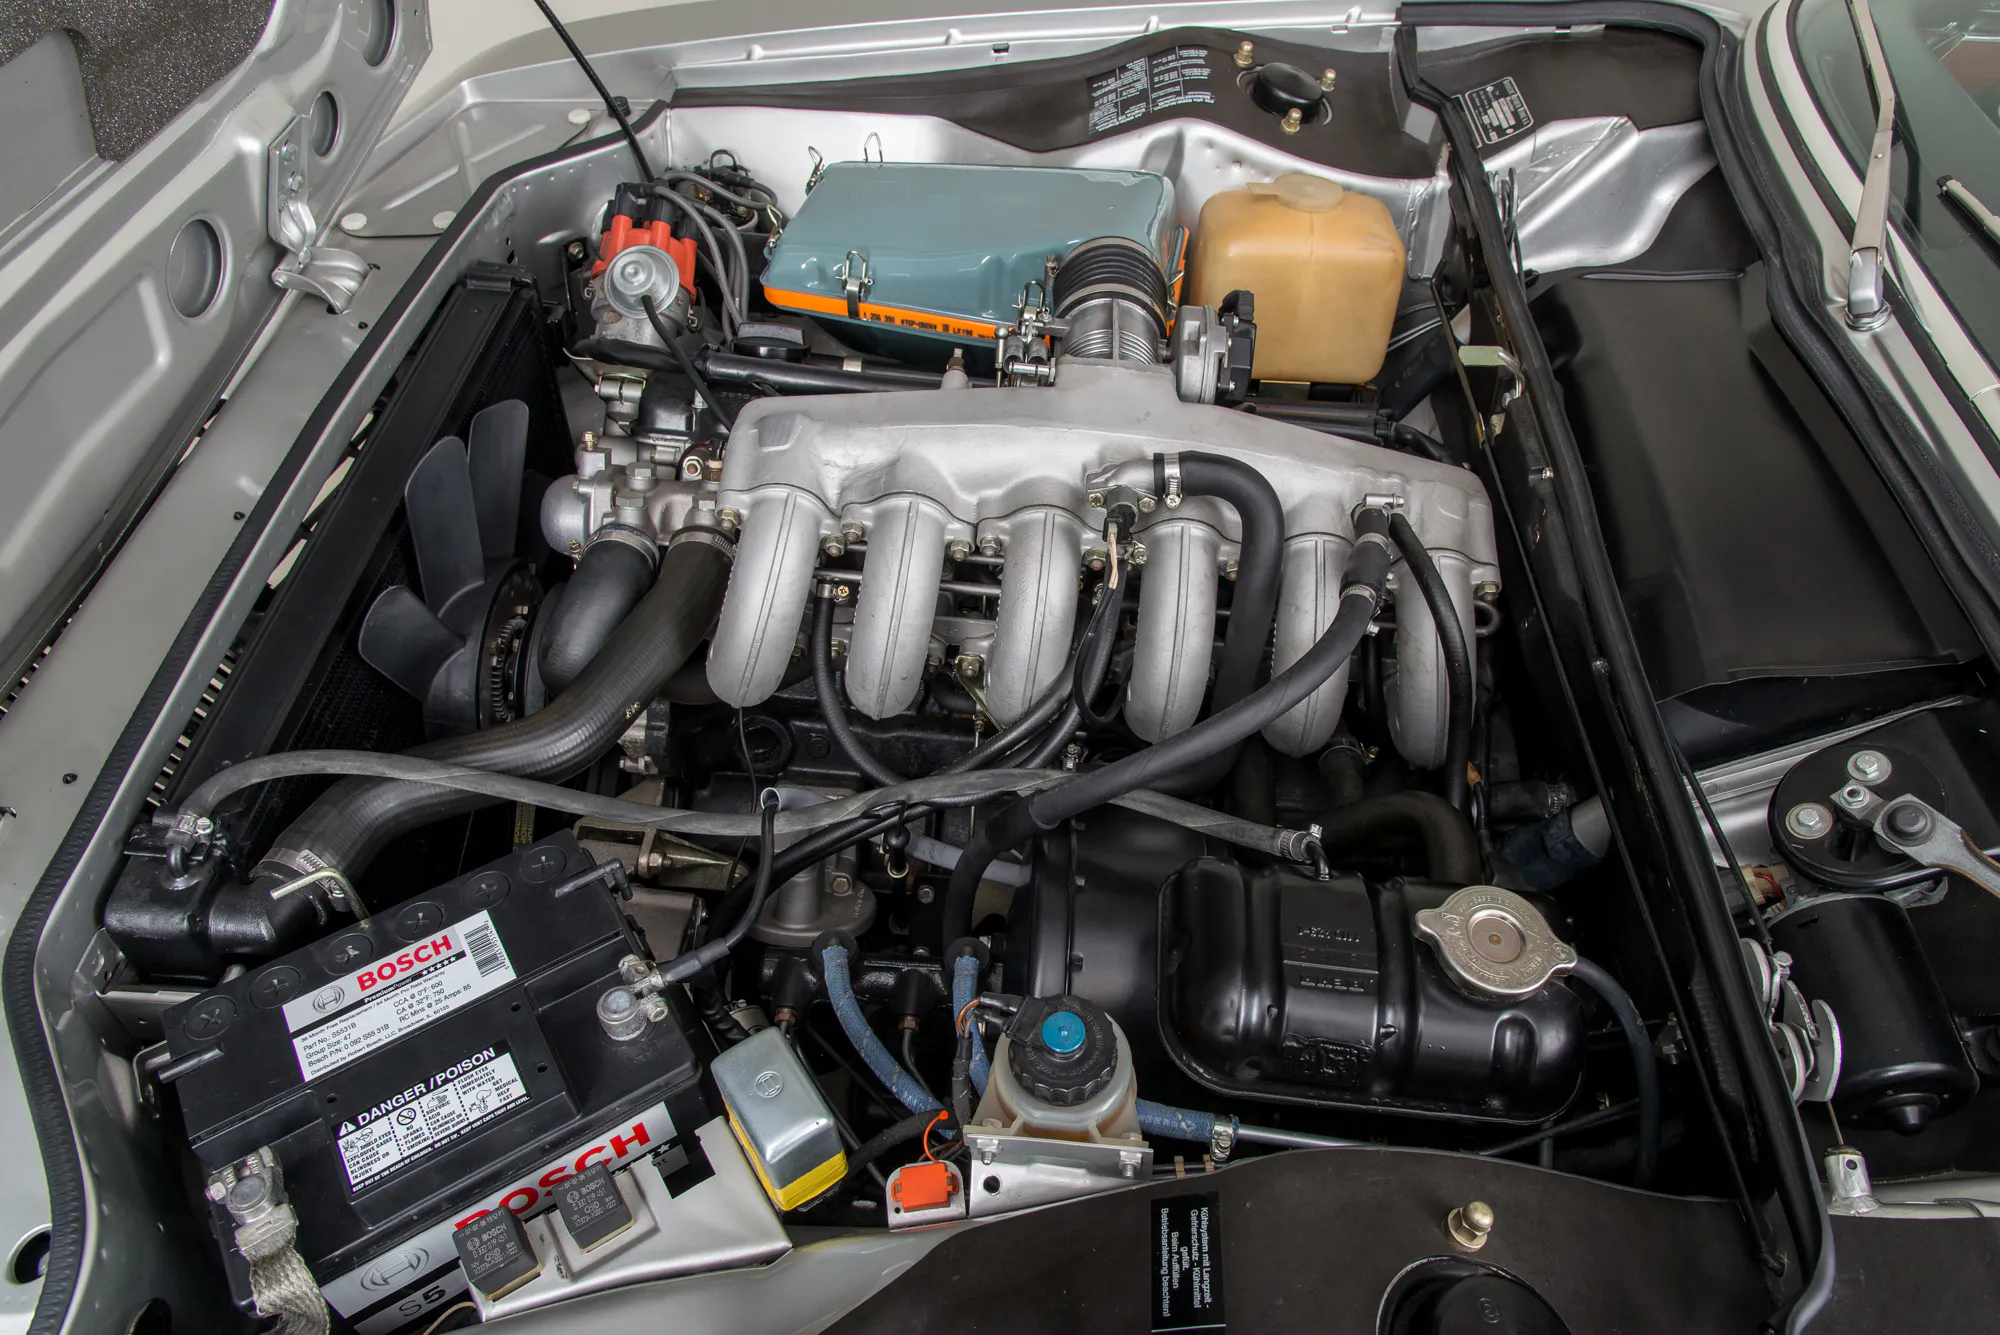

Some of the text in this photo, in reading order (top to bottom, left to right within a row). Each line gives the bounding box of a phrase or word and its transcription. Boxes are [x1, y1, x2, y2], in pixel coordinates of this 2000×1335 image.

[355, 934, 452, 992] BOSCH
[392, 996, 408, 1008] CCA
[409, 992, 416, 1000] @
[430, 979, 443, 989] 600
[395, 1006, 406, 1015] CA
[432, 987, 444, 997] 750
[308, 1027, 325, 1039] Month
[326, 1021, 338, 1030] Free
[338, 1004, 372, 1025] Replacement
[383, 991, 400, 1002] Month
[410, 981, 422, 989] Rata
[422, 969, 446, 984] Warranty
[398, 1013, 409, 1023] RC
[410, 1005, 425, 1017] Mins
[433, 997, 442, 1005] 25
[442, 987, 463, 1001] Amps:
[302, 1041, 316, 1051] Part
[305, 1033, 352, 1060] Group Size: 47
[307, 1052, 328, 1067] Bosch
[329, 1046, 343, 1057] P/N:
[349, 1036, 362, 1046] 092
[375, 1023, 390, 1034] 31B
[310, 1057, 339, 1075] Distributed
[339, 1054, 347, 1062] by
[347, 1044, 365, 1057] Robert
[457, 1065, 488, 1084] FLUSH EYES
[459, 1068, 496, 1090] IMMEDIATELY
[492, 1077, 503, 1086] GET
[494, 1077, 518, 1091] MEDICAL
[461, 1075, 495, 1095] WITH WATER
[496, 1087, 511, 1097] HELP
[356, 1081, 427, 1126] DANGER
[425, 1099, 450, 1115] SULFURIC
[498, 1092, 513, 1103] FAST
[427, 1111, 440, 1120] ACID
[429, 1109, 456, 1126] CAN CAUSE
[431, 1116, 456, 1131] BLINDNESS
[402, 1126, 423, 1139] SPARKS
[433, 1117, 466, 1137] SEVERE BURNS
[351, 1182, 365, 1192] KEEP
[364, 1177, 375, 1185] OUT
[380, 1169, 390, 1177] THE
[389, 1161, 404, 1172] REACH
[440, 1136, 450, 1144] NOT
[459, 1125, 471, 1134] KEEP
[471, 1119, 483, 1128] VENT
[482, 1113, 494, 1122] CAPS
[494, 1106, 506, 1116] TIGHT
[506, 1101, 516, 1109] AND
[359, 1130, 391, 1150] SHIELD EYES
[404, 1131, 425, 1145] FLAMES
[406, 1135, 430, 1150] SMOKING
[346, 1136, 392, 1163] EXPLOSIVE GASES
[348, 1149, 380, 1168] CAN CAUSE
[350, 1156, 380, 1174] BLINDNESS
[351, 1166, 373, 1180] INJURY
[579, 1176, 605, 1195] BOSCH
[594, 1187, 606, 1197] 451
[480, 1222, 507, 1241] BOSCH
[1190, 1209, 1199, 1260] Gefrierschutz
[1199, 1207, 1209, 1252] Kühlsystem
[471, 1250, 478, 1258] 0
[486, 1238, 498, 1249] 019
[496, 1232, 508, 1243] 451
[1160, 1208, 1170, 1316] Betriebsanleitung beachten!
[1202, 1253, 1210, 1266] mit
[1192, 1267, 1201, 1307] Kühlmittel
[1201, 1268, 1211, 1302] Langzeit
